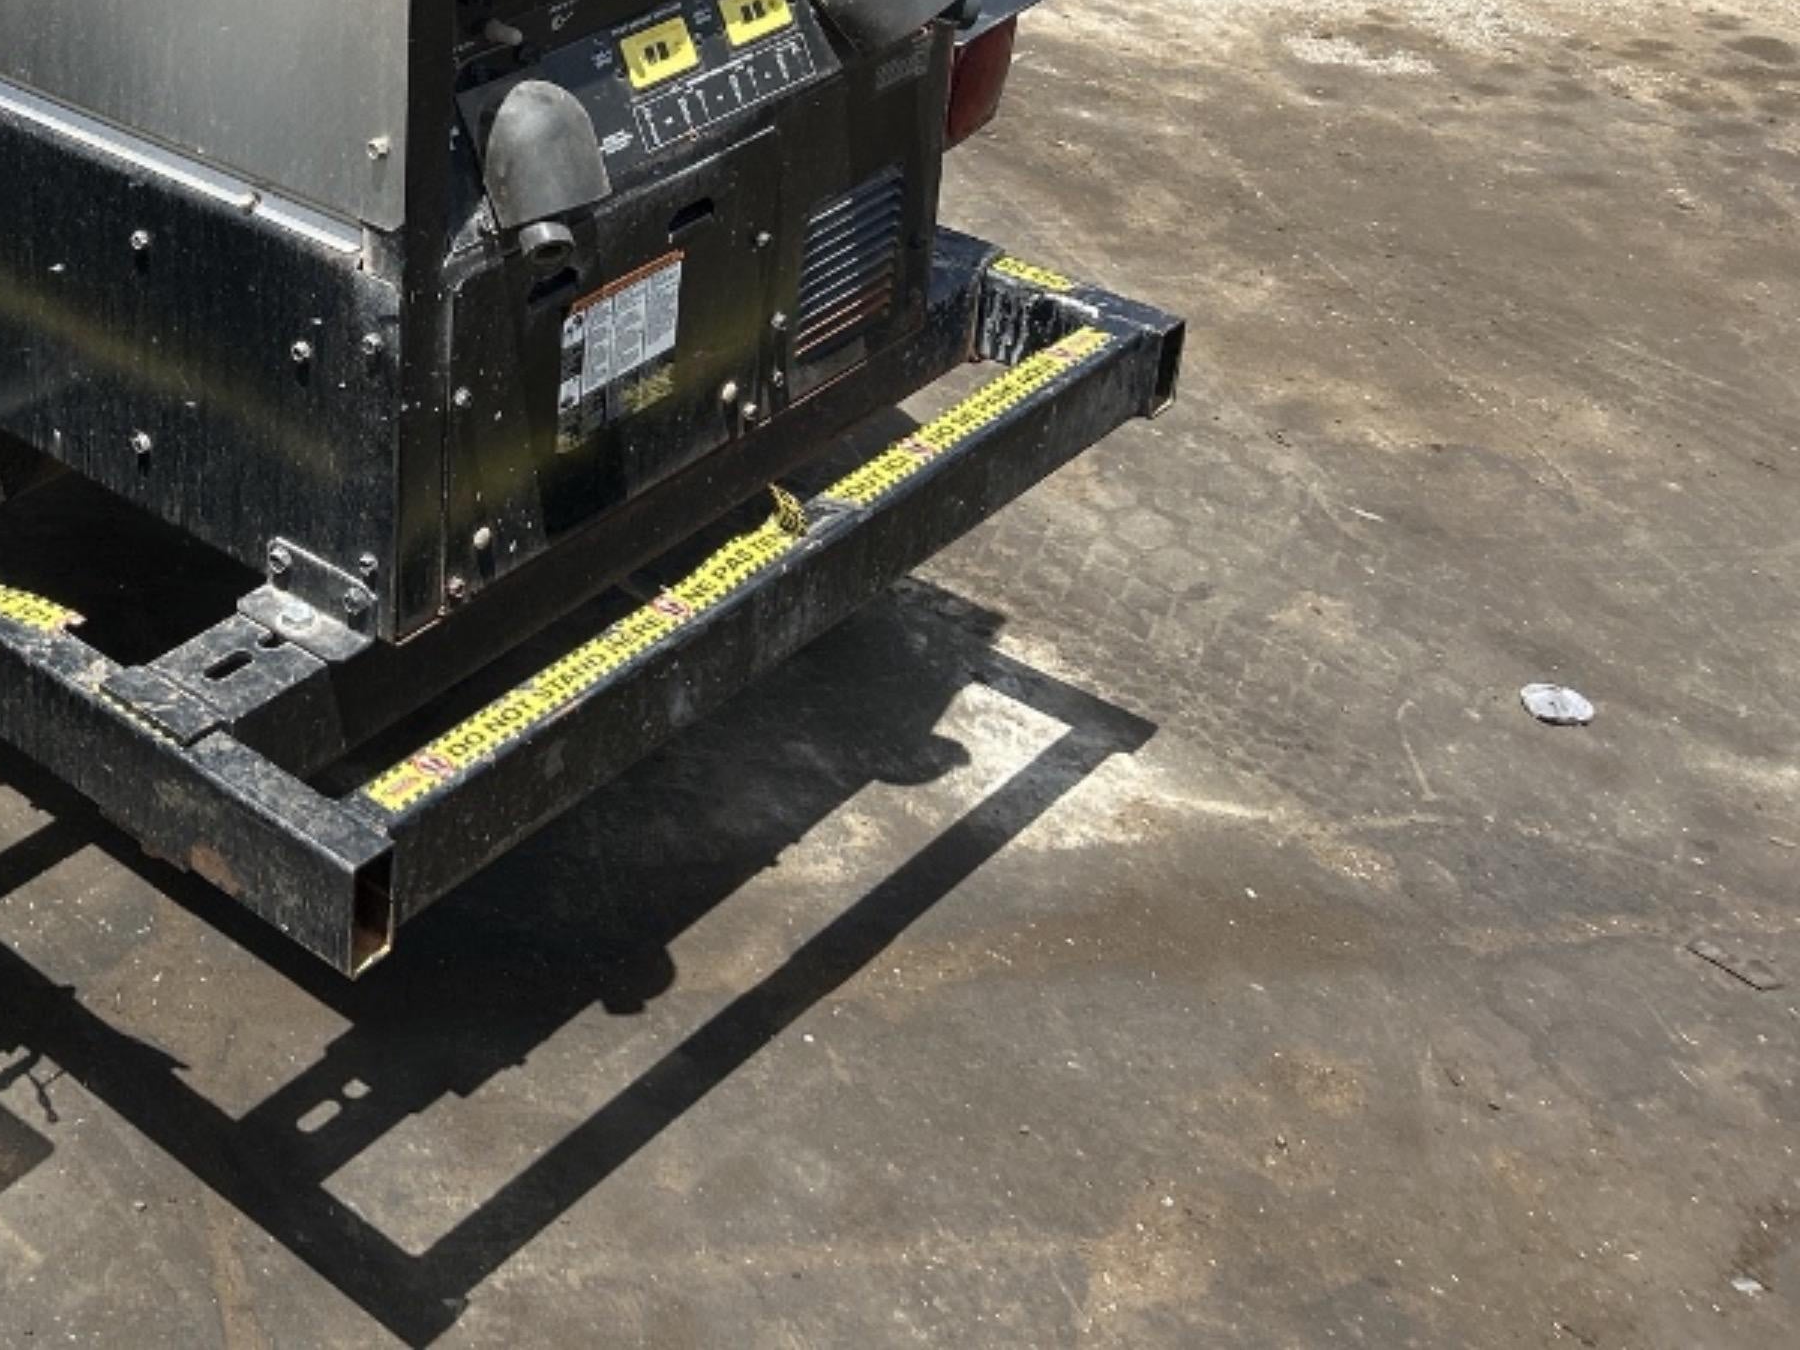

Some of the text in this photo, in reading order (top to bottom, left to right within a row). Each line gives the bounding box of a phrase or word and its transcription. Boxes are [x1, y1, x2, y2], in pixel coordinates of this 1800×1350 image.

[681, 578, 719, 601] NE
[711, 548, 755, 580] PAS
[447, 731, 487, 758] DO
[484, 698, 533, 732] NOT
[533, 651, 607, 702] STAND
